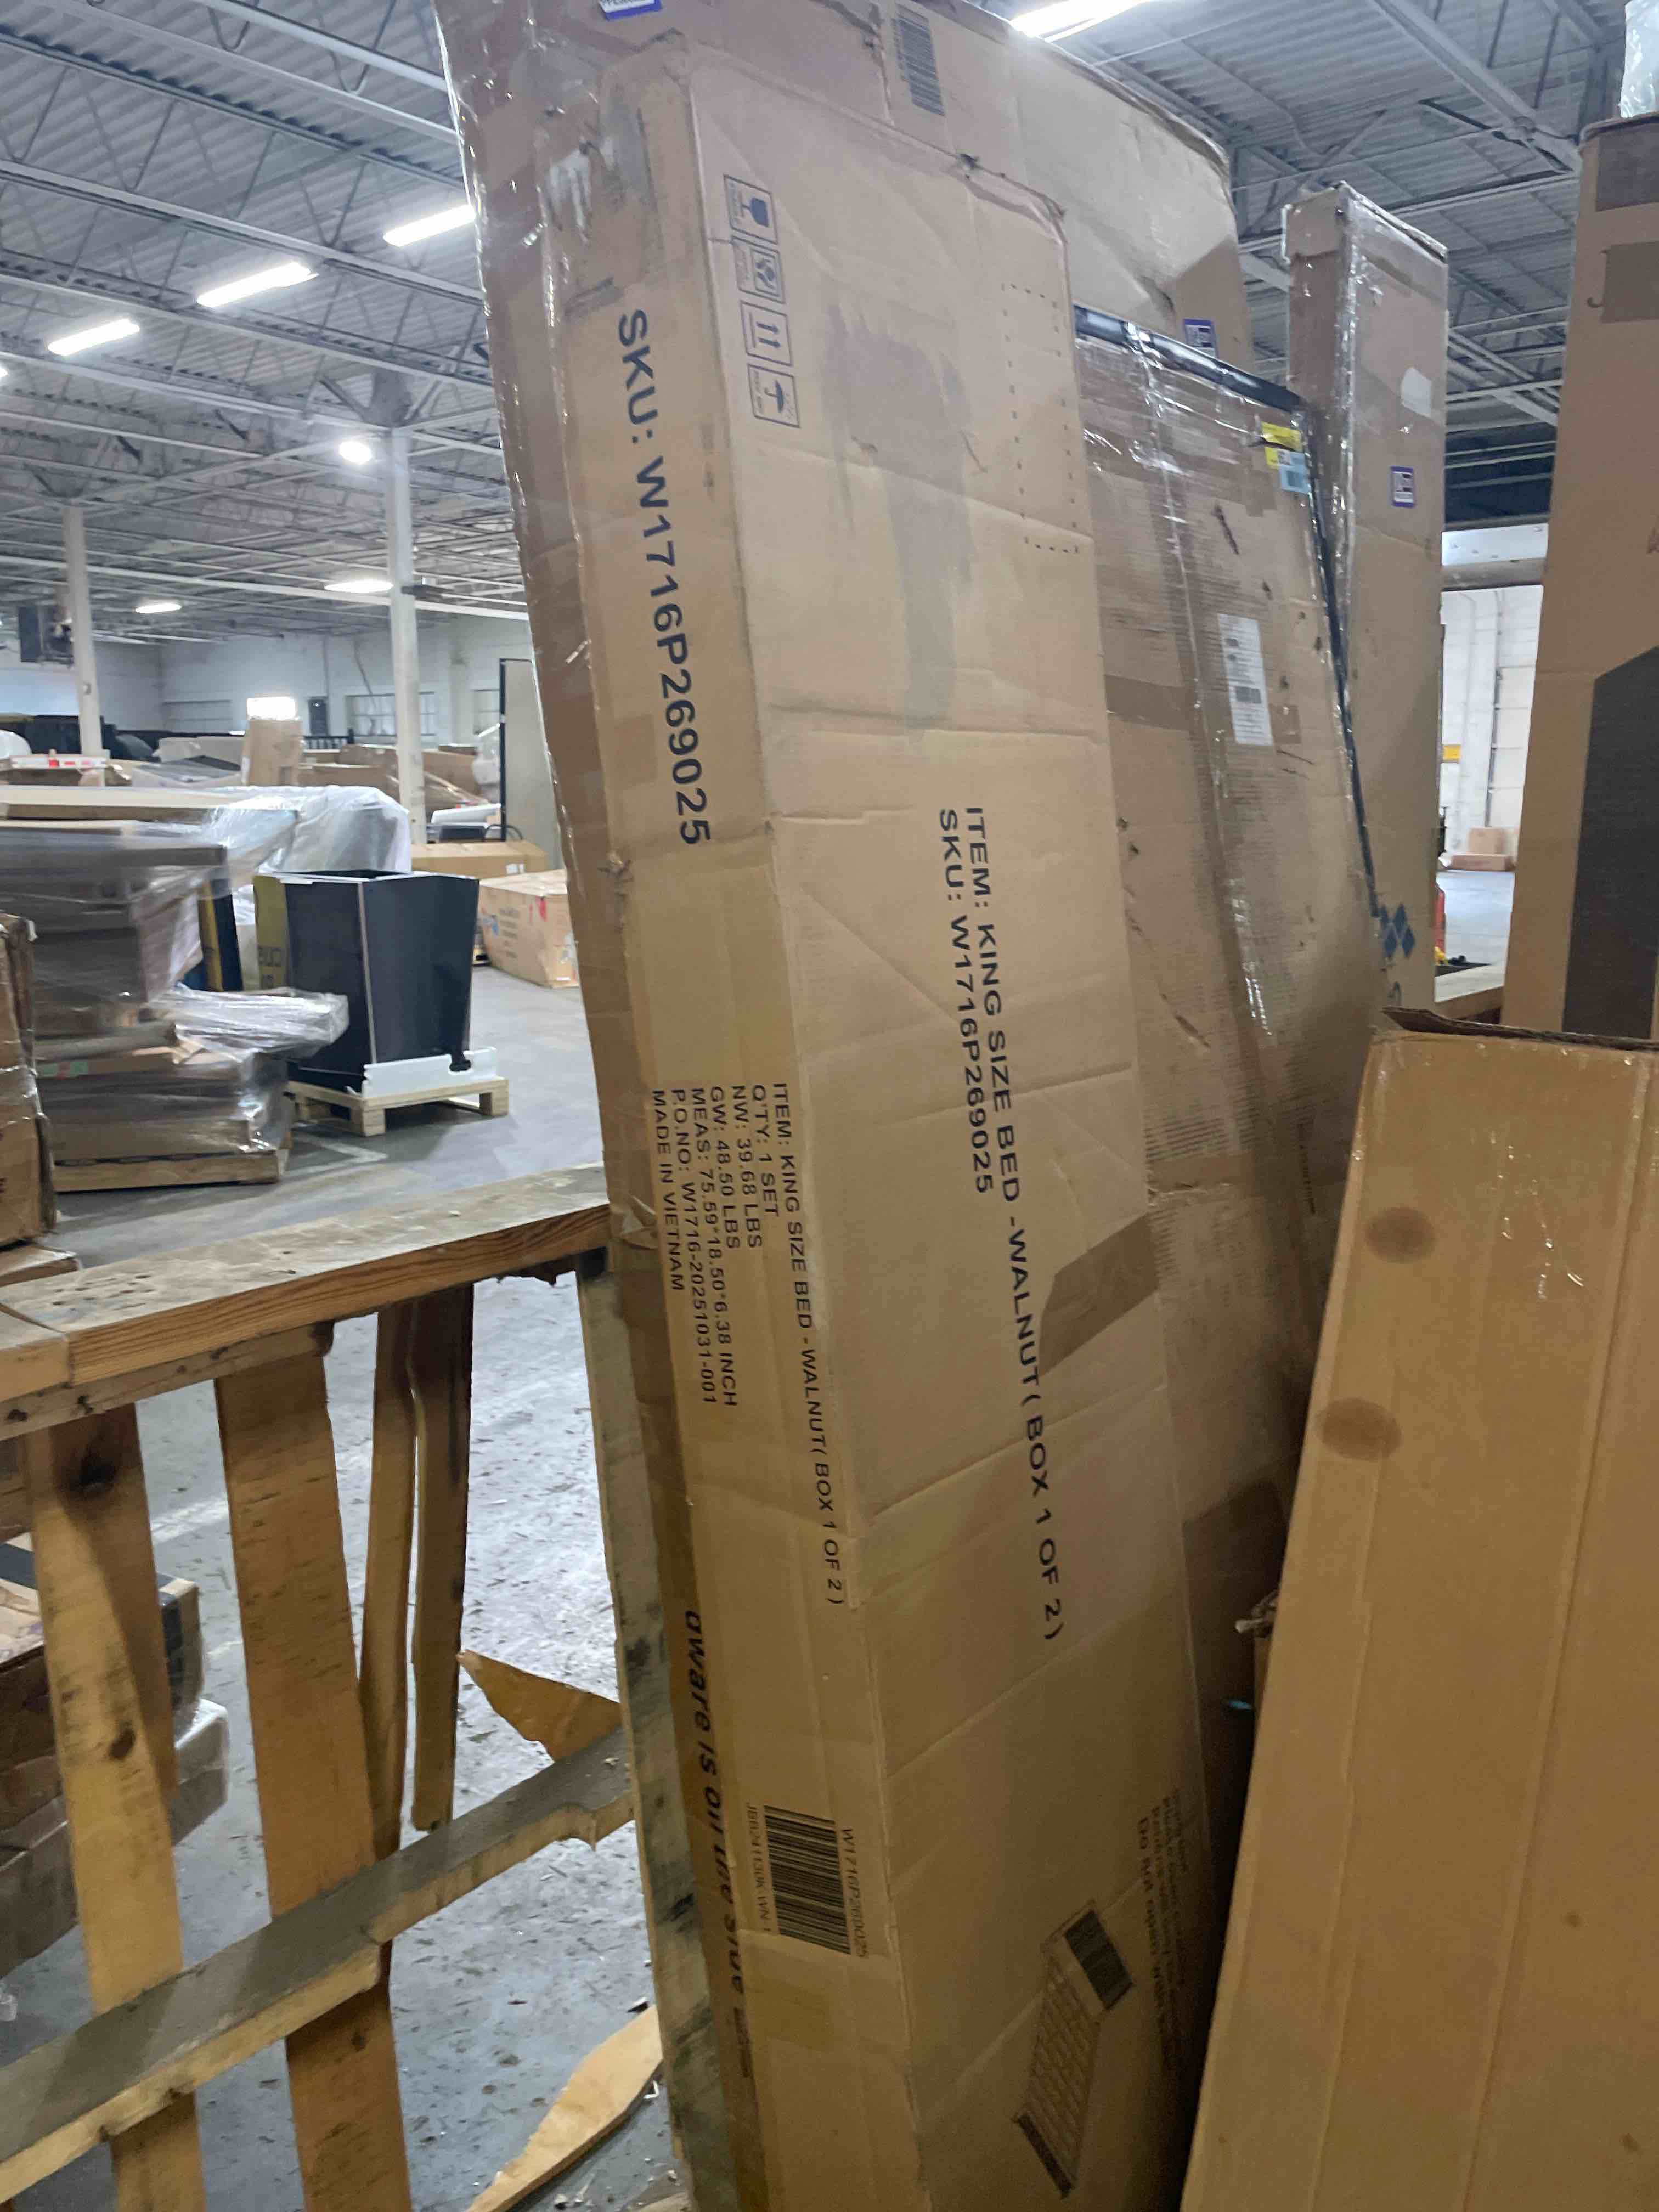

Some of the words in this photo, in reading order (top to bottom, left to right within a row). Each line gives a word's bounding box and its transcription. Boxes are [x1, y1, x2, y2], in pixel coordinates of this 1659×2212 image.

[618, 309, 659, 444] SKU:
[636, 456, 712, 845] W1716P269025
[939, 809, 965, 901] SKU:
[965, 807, 992, 908] ITEM:
[977, 923, 1002, 1016] KING
[950, 914, 994, 1193] W1716P269025
[987, 1030, 1012, 1113] SIZE
[652, 1090, 671, 1154] MADE
[671, 1088, 692, 1171] P.O.NO:
[710, 1086, 727, 1131] GW:
[731, 1085, 750, 1129] NW:
[772, 1083, 792, 1146] ITEM:
[659, 1163, 674, 1183] IN
[716, 1139, 735, 1197] 48.50
[736, 1138, 757, 1195] 39.68
[758, 1153, 773, 1162] 1
[780, 1155, 800, 1213] KING
[996, 1125, 1020, 1202] BED
[761, 1172, 780, 1217] SET
[663, 1192, 685, 1290] VIETNAM
[691, 1088, 711, 1160] MEAS:
[719, 1352, 738, 1406] INCH
[722, 1205, 741, 1249] LBS
[743, 1204, 763, 1248] LBS
[787, 1221, 807, 1271] SIZE
[681, 1182, 718, 1403] W1716-20251031-001
[794, 1280, 812, 1329] BED
[1026, 1414, 1049, 1497] BOX
[815, 1463, 834, 1511] BOX
[822, 1521, 837, 1529] 1
[1035, 1508, 1052, 1525] 1
[823, 1539, 840, 1571] OF
[1039, 1538, 1059, 1585] OF
